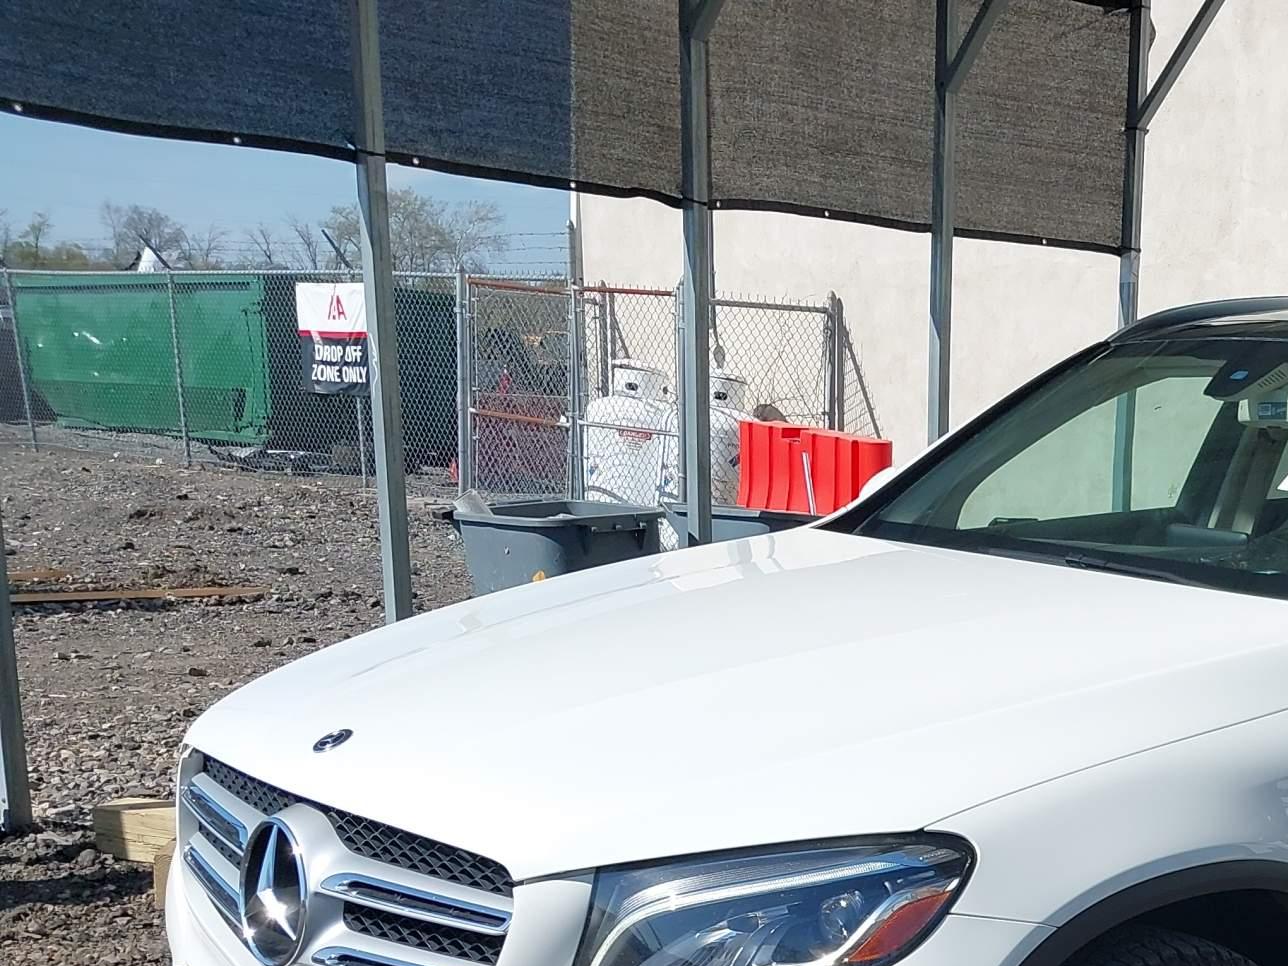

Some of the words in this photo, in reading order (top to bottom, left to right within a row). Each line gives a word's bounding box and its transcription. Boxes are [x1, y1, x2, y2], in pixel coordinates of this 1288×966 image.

[315, 344, 343, 362] DROP
[345, 345, 362, 362] OFF
[312, 364, 341, 382] ZONE
[342, 366, 367, 383] ONLY
